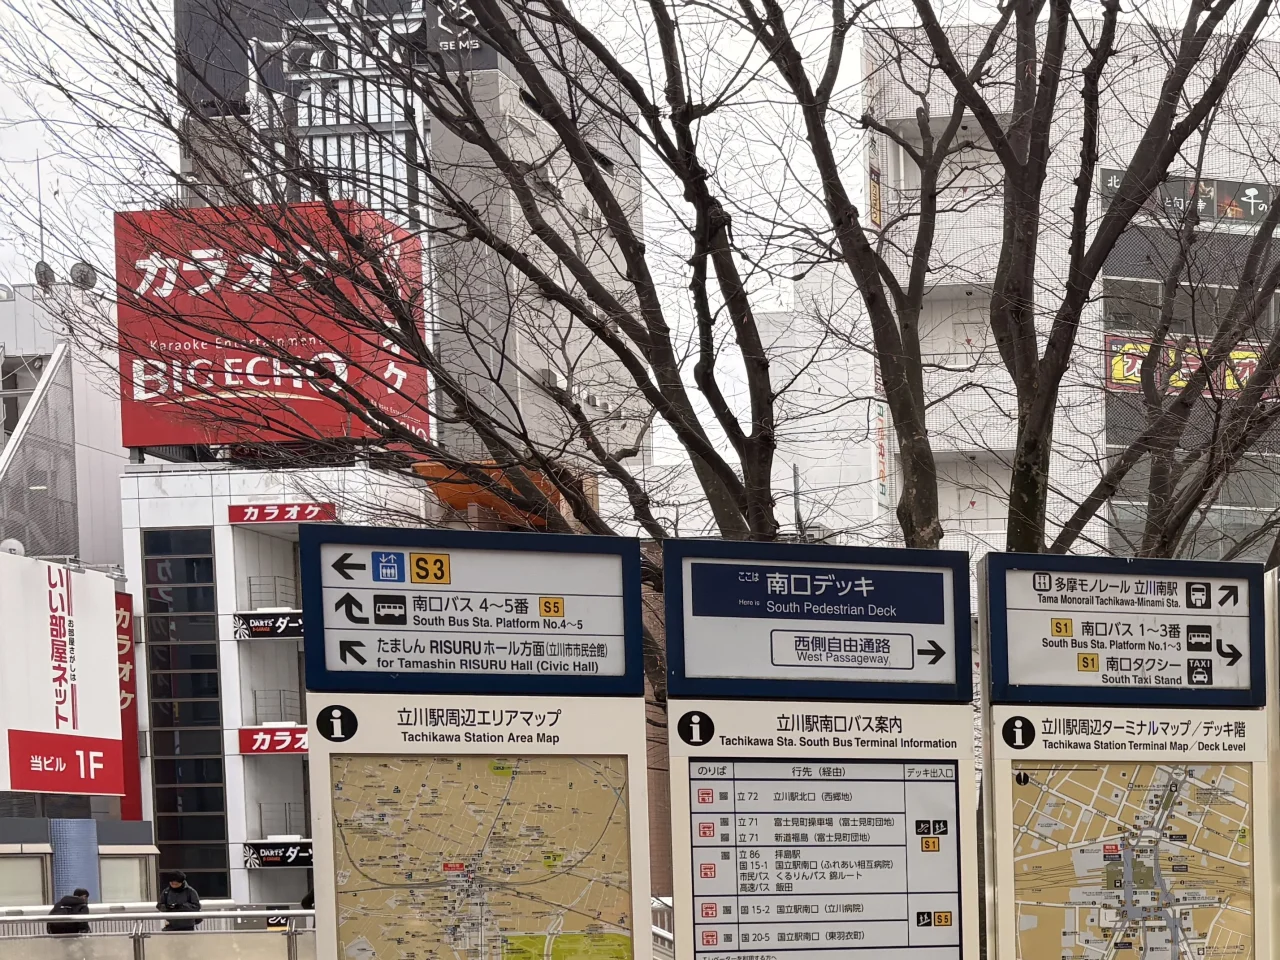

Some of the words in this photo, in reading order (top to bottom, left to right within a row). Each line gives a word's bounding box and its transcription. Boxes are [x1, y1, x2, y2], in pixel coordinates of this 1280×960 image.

[440, 40, 479, 50] GEMS
[150, 339, 208, 351] Karaoke
[131, 360, 214, 402] BIG
[224, 352, 348, 395] ECHO
[243, 504, 321, 521] カラオケ
[415, 557, 445, 580] S3
[738, 572, 760, 582] ここは
[766, 572, 875, 598] 南口デッキ
[1055, 576, 1130, 593] 多摩モノレール
[1134, 580, 1178, 596] 立川南駅
[412, 595, 474, 613] 南口バス
[543, 600, 560, 614] S5
[1038, 594, 1059, 604] Tama
[1060, 595, 1094, 605] Monorail
[1095, 596, 1165, 608] Tachikawa-Minami
[1167, 599, 1181, 608] Sta.
[766, 601, 800, 614] South
[804, 602, 865, 616] Pedestrian
[868, 604, 897, 617] Deck
[412, 615, 446, 627] South
[448, 616, 470, 627] Bus
[472, 616, 493, 628] Sta.
[496, 617, 540, 629] Platform
[47, 565, 68, 729] いい部屋ネット
[68, 619, 77, 682] お部屋さがしは
[794, 636, 890, 654] 西側自由通路
[1042, 638, 1069, 648] South
[1071, 639, 1089, 649] Bus
[1090, 639, 1108, 649] Sta.
[1110, 640, 1146, 651] Platform
[114, 607, 135, 710] カラオケ
[377, 658, 394, 668] for
[397, 658, 456, 669] Tamashin
[459, 659, 507, 670] RISURU
[511, 660, 533, 671] Hall
[536, 660, 570, 673] (Civic
[572, 661, 599, 674] Hall)
[797, 652, 822, 662] West
[826, 652, 890, 666] Passageway
[1082, 657, 1095, 668] S1
[1106, 657, 1182, 672] 南口タクシー
[1189, 660, 1211, 668] TAXI
[1102, 674, 1130, 684] South
[1132, 675, 1153, 685] Taxi
[1155, 676, 1182, 685] Stand
[397, 707, 562, 727] 立川駅周辺エリアマップ
[776, 714, 902, 734] 立川駅南口バス案内
[1041, 718, 1246, 738] 立川駅周辺ターミナルマップ／デッキ階
[401, 731, 461, 743] Tachikawa
[464, 731, 504, 744] Station
[507, 732, 533, 744] Area
[536, 733, 560, 746] Map
[719, 735, 774, 747] Tachikawa
[777, 736, 797, 747] Sta.
[799, 736, 830, 747] South
[833, 737, 853, 747] Bus
[854, 738, 898, 748] Terminal
[900, 738, 958, 749] Information
[1043, 740, 1091, 750] Tachikawa
[1094, 740, 1127, 750] Station
[1129, 741, 1168, 751] Terminal
[1222, 742, 1246, 752] Level
[29, 755, 66, 772] 当ビル
[75, 749, 104, 780] 1F
[698, 766, 727, 776] のりば
[907, 768, 954, 778] デッキ出入口
[924, 840, 936, 849] S1
[740, 871, 770, 881] 市民バス
[776, 870, 826, 881] くるりんバス
[829, 871, 863, 880] 錦ルート
[740, 882, 770, 892] 高速バス
[776, 882, 793, 892] 飯田
[937, 914, 949, 923] S5
